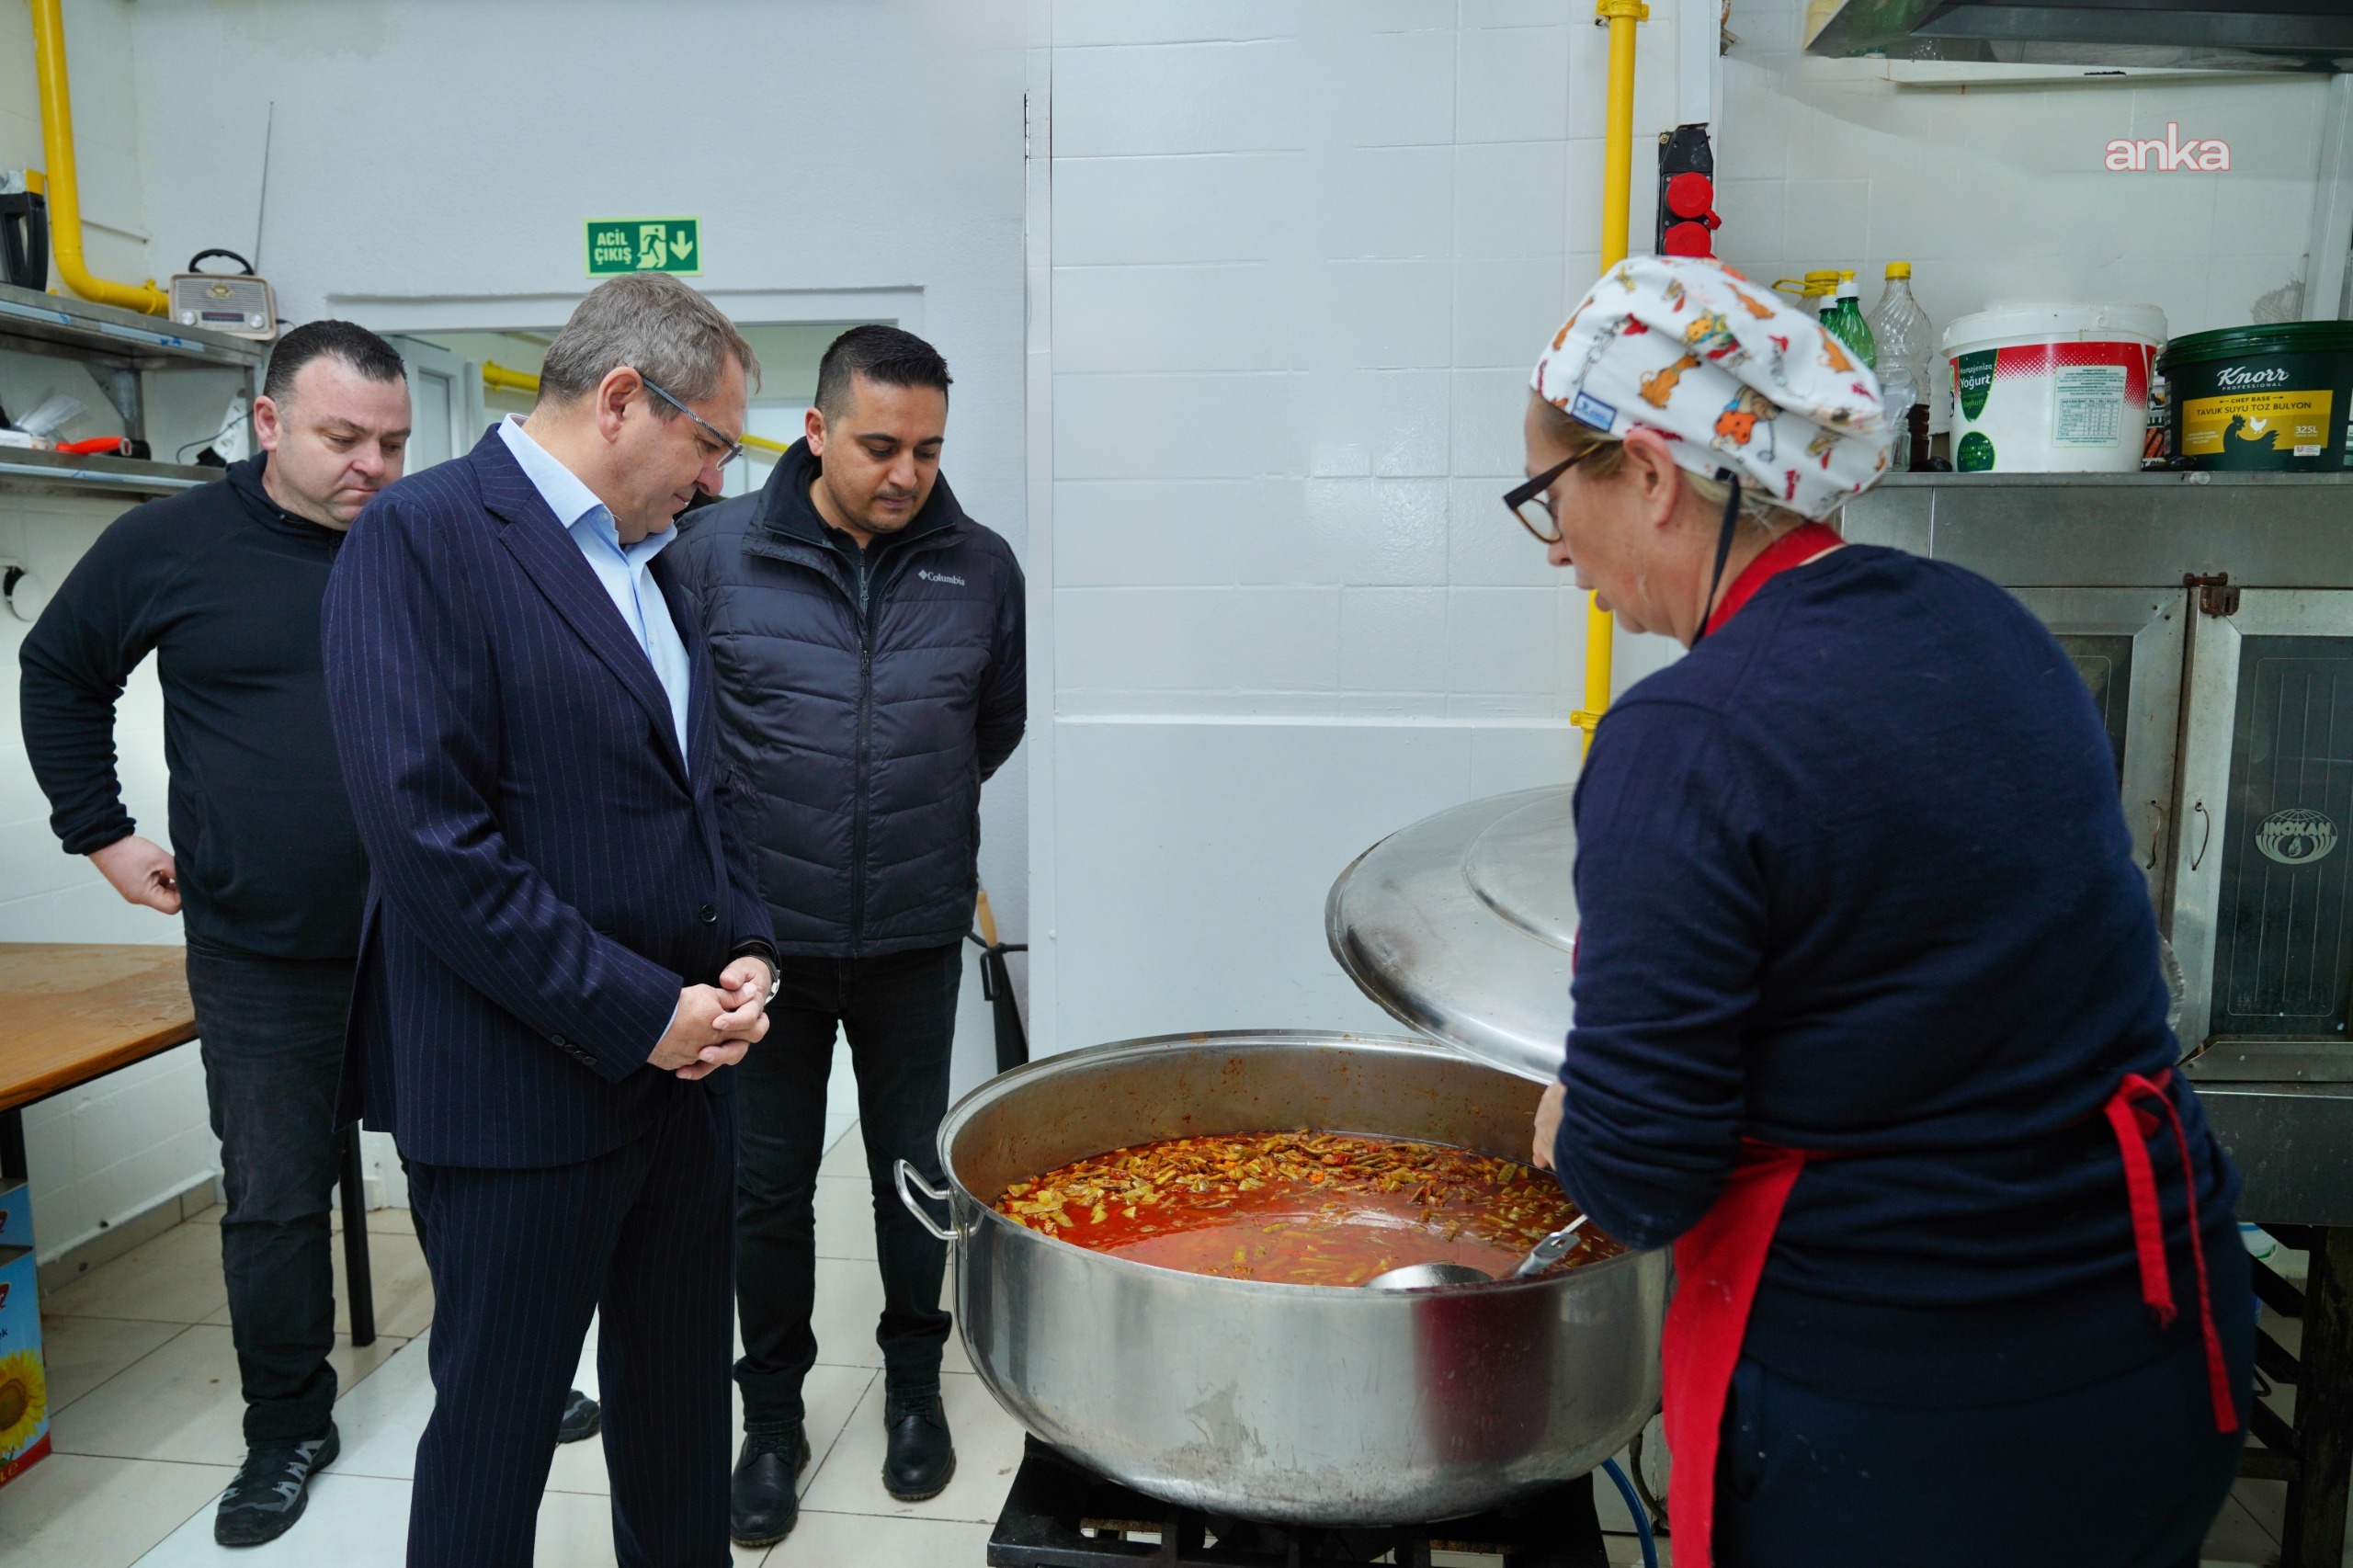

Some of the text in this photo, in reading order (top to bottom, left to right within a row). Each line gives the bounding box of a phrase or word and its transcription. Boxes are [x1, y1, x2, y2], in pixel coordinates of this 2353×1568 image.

[596, 228, 629, 246] ACİL
[594, 246, 632, 266] ÇIKIŞ
[1961, 374, 1991, 390] Yoğurt
[2216, 366, 2290, 387] Knorr
[2222, 382, 2281, 391] PROFESSIONAL
[2196, 401, 2312, 416] TAVUK SUYU TOZ BULYON
[2294, 426, 2319, 434] 325L
[927, 572, 965, 585] Columbia
[2263, 821, 2332, 836] INOXAN
